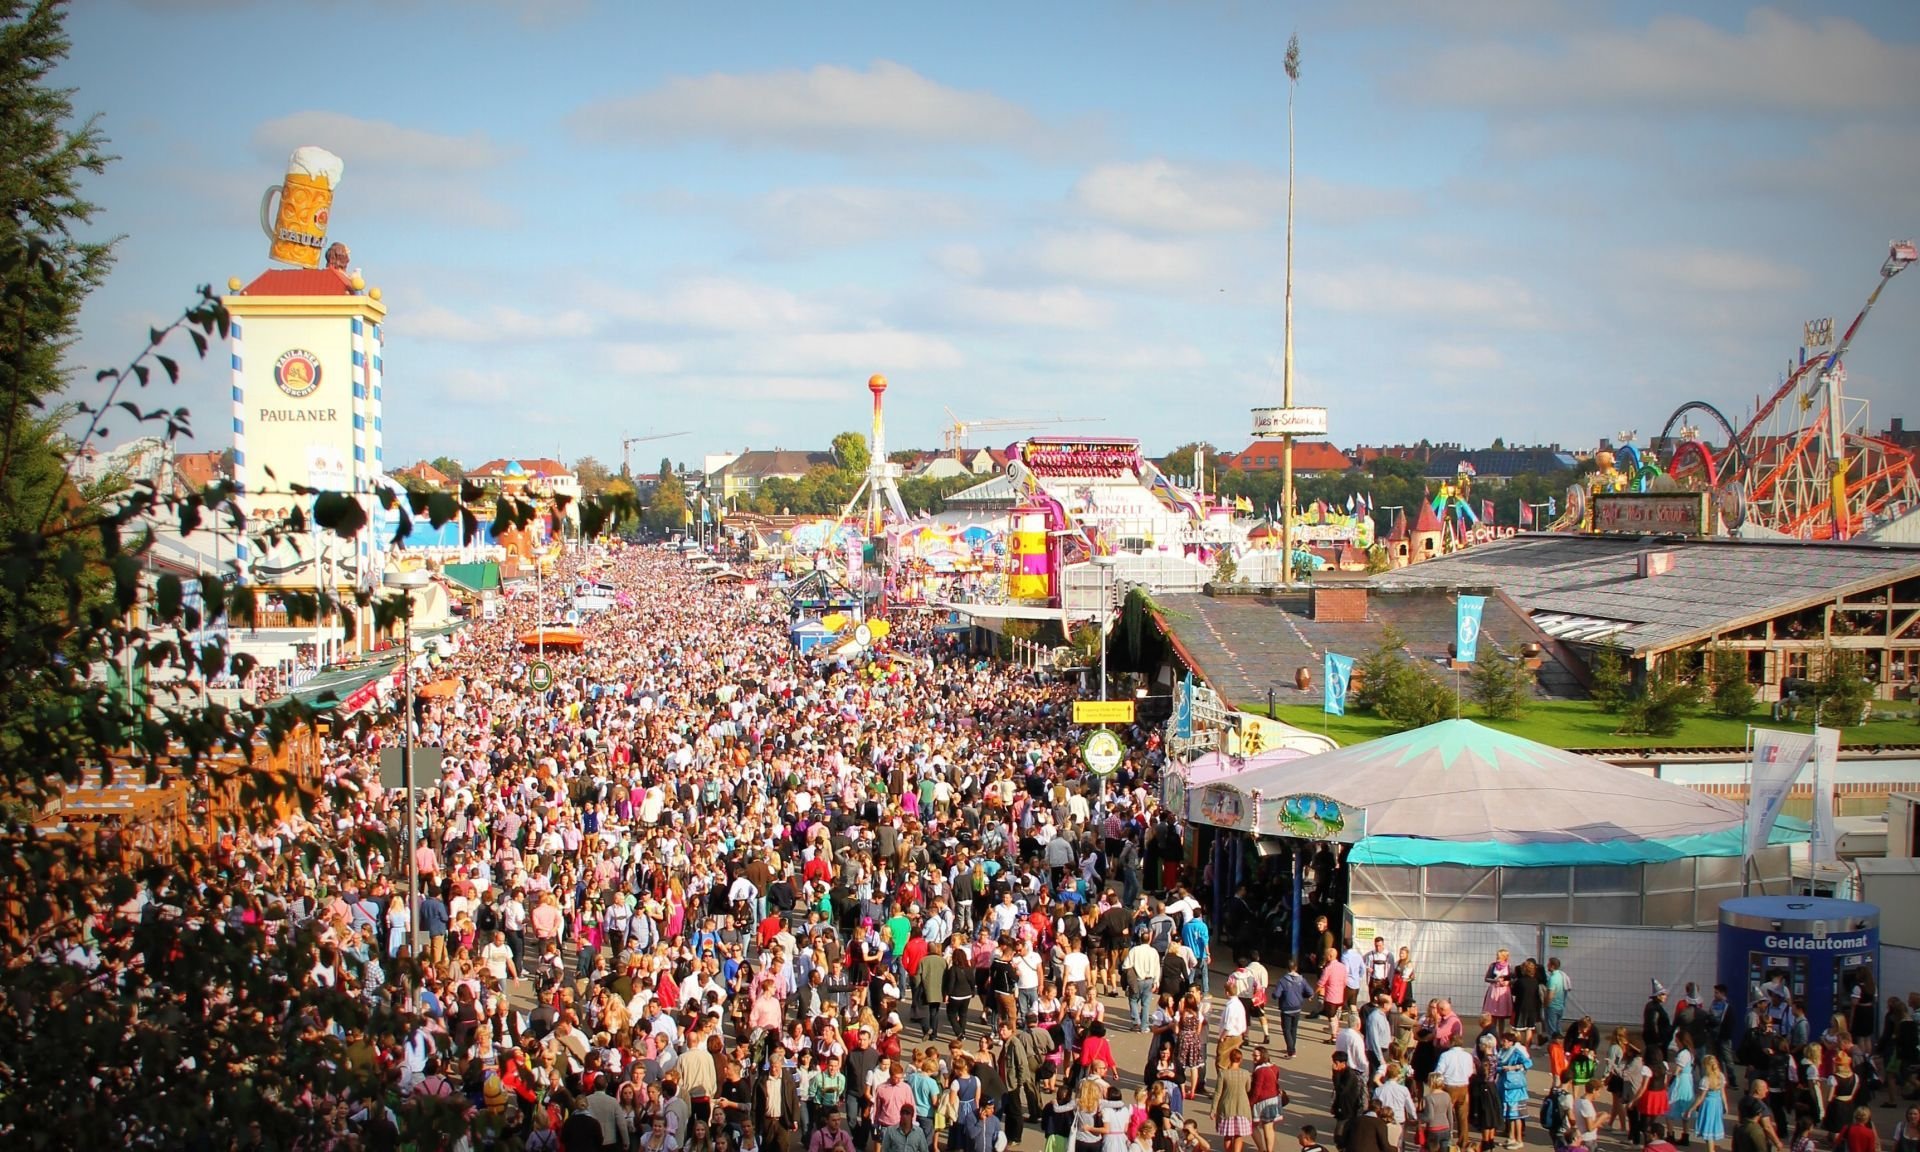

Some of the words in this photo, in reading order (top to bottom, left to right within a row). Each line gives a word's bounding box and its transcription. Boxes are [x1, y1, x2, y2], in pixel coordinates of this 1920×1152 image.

[260, 408, 337, 422] PAULANER
[1466, 526, 1527, 543] SCHLO
[1764, 934, 1868, 950] Geldautomat
